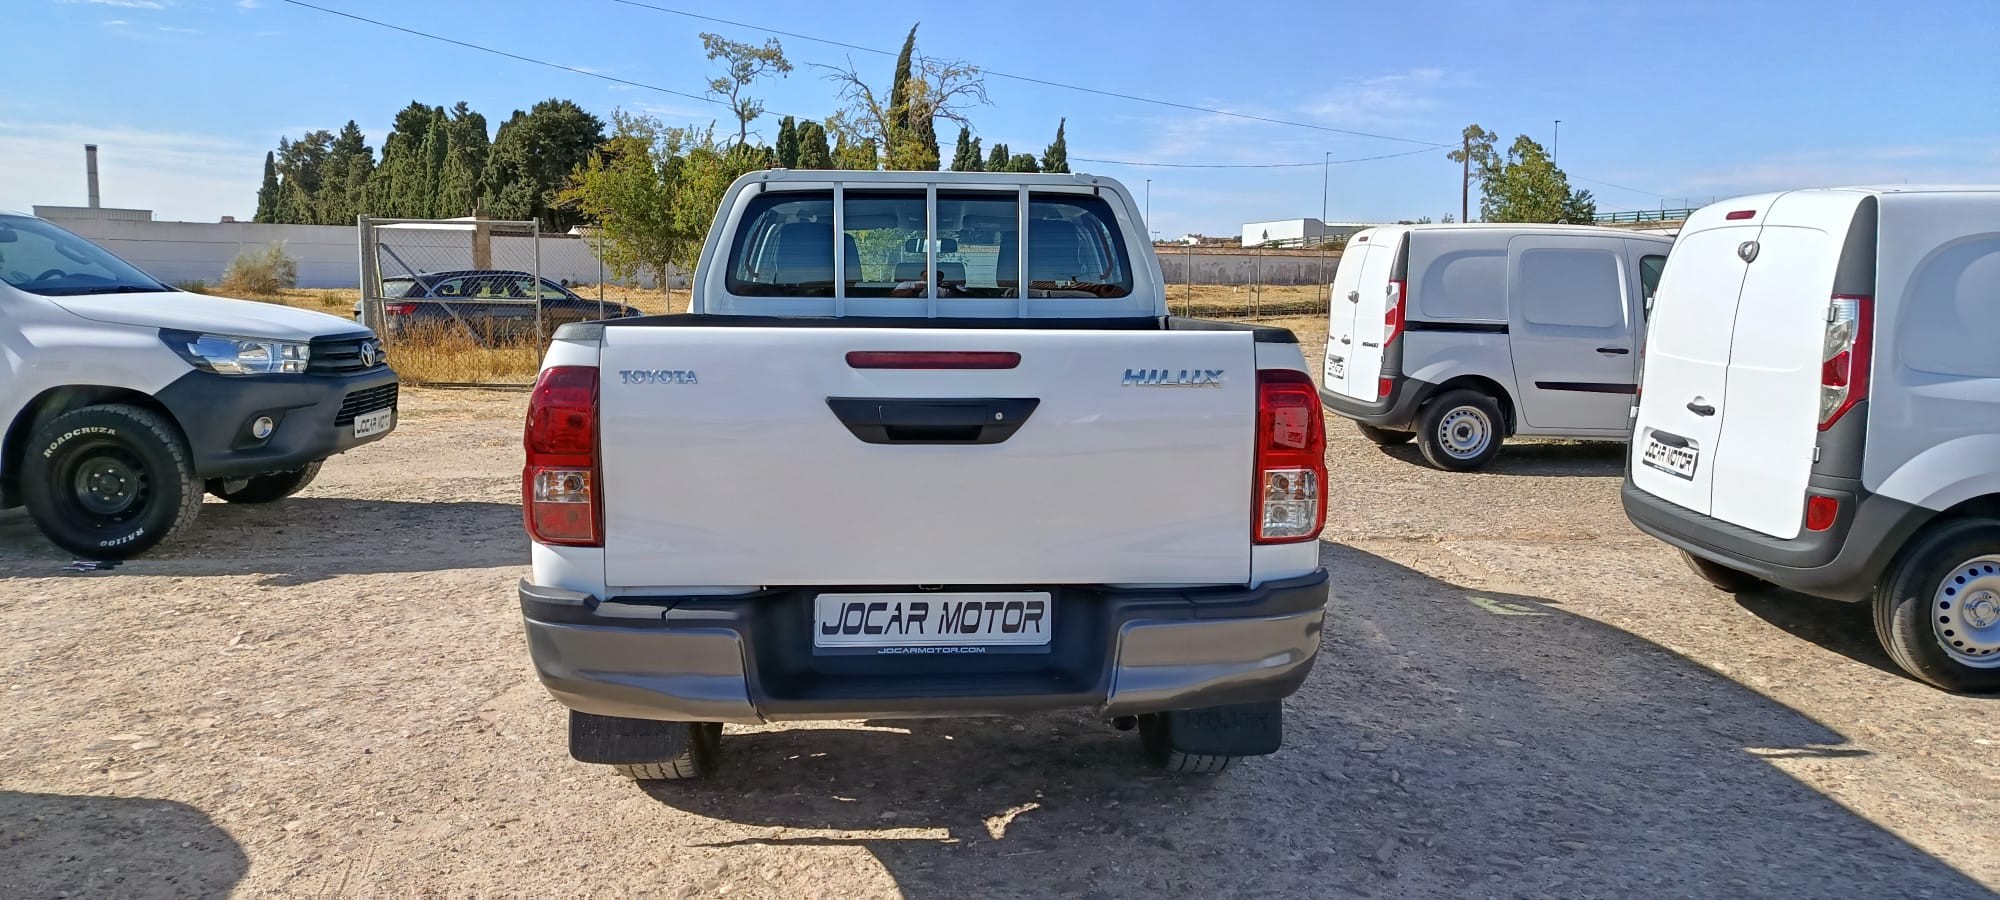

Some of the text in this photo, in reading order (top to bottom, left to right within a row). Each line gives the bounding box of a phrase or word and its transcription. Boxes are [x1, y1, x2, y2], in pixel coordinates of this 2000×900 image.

[619, 369, 698, 384] TOYOTA
[1122, 368, 1224, 387] HILUX
[43, 427, 116, 458] ROADCRUZA
[821, 600, 1045, 635] JOCAR MOTOR
